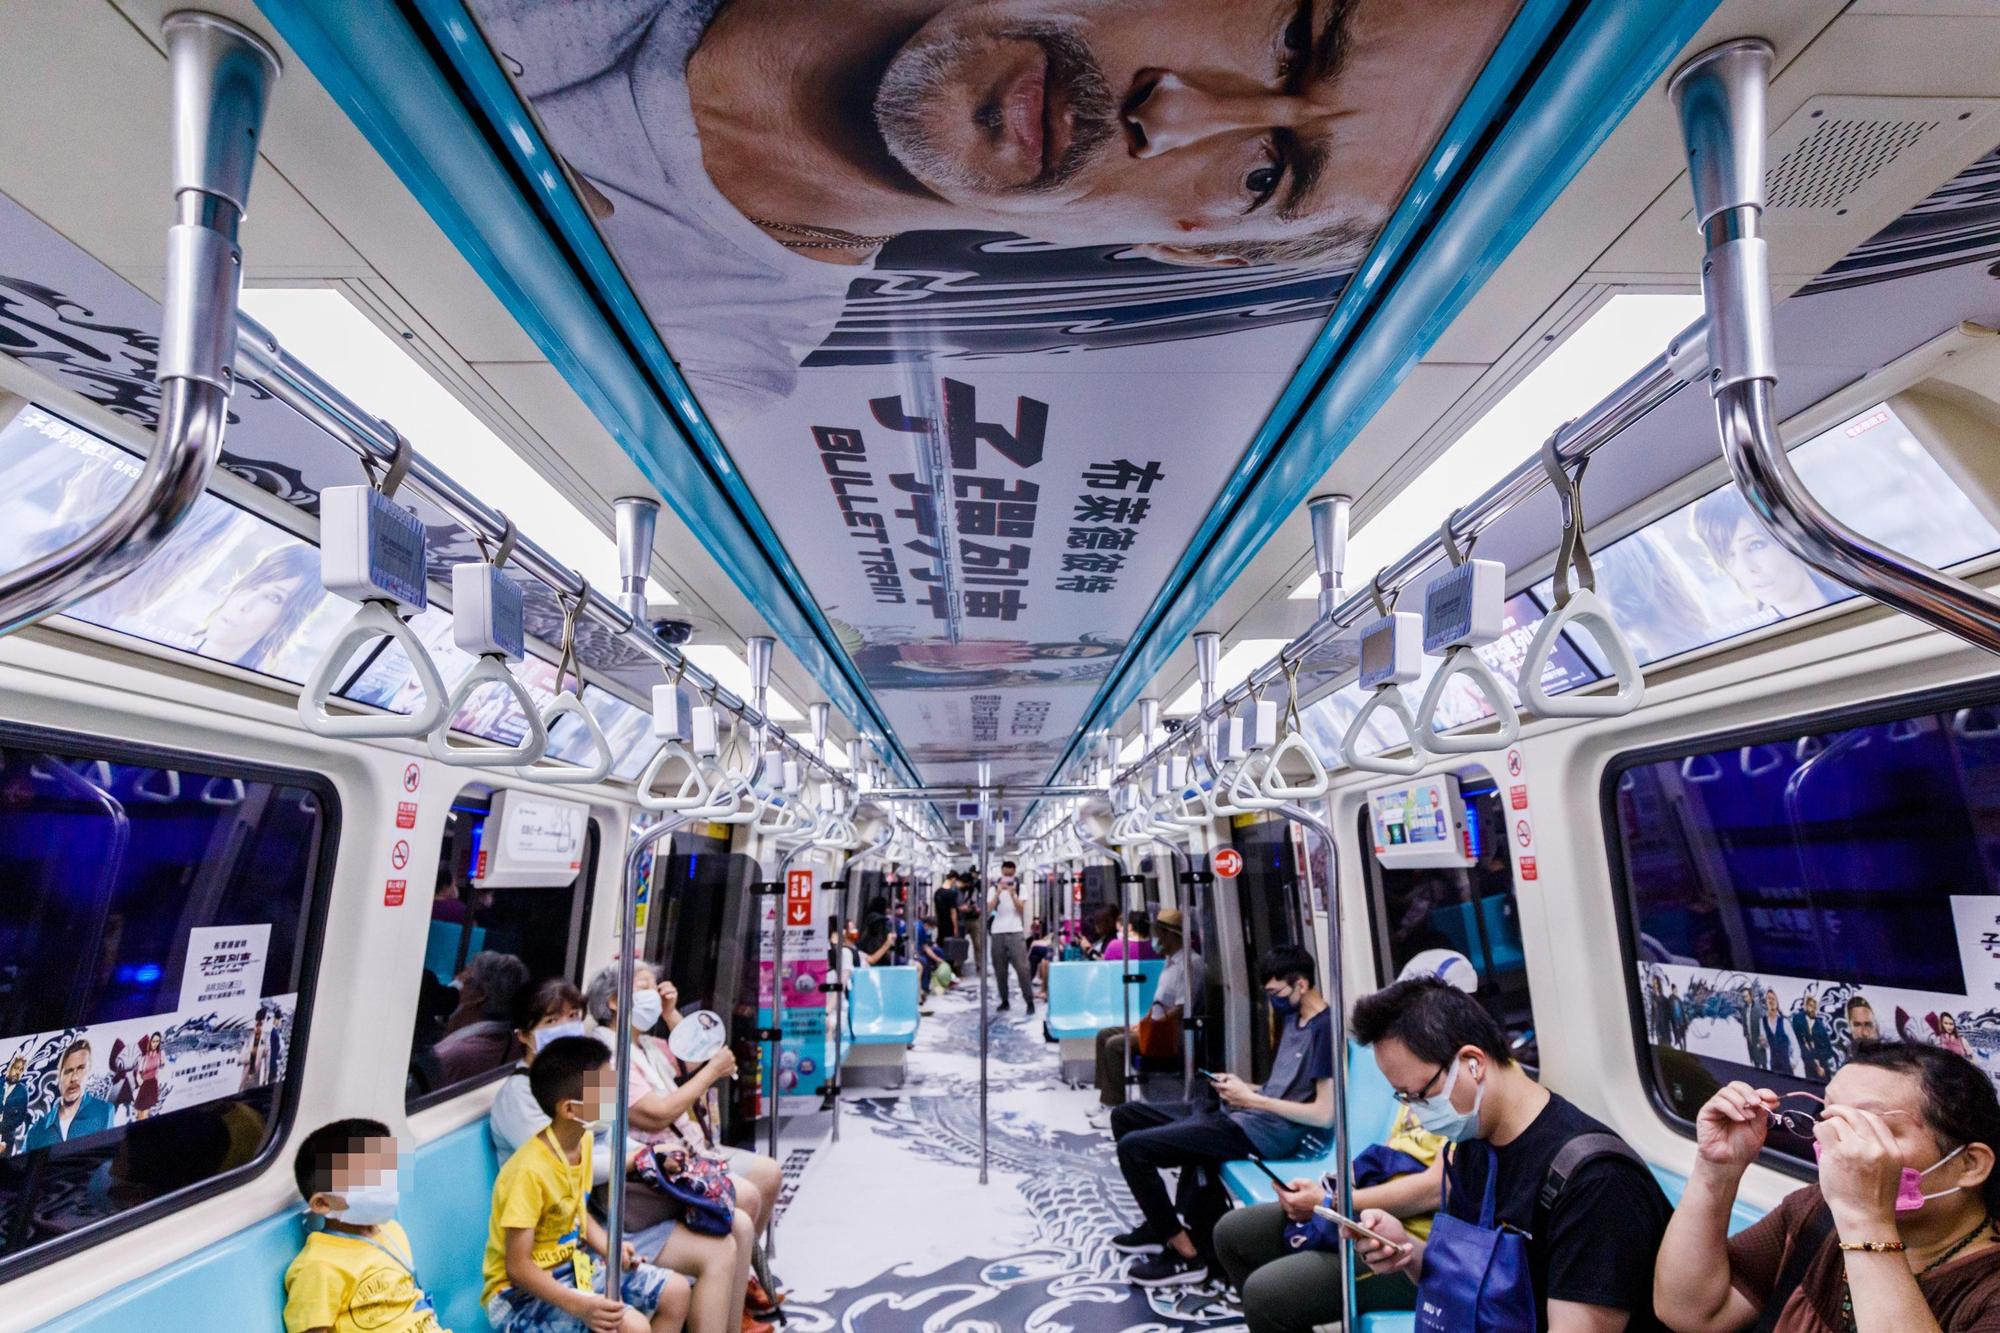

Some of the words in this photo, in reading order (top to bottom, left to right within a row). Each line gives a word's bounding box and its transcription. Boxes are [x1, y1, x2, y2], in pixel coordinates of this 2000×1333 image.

[810, 425, 890, 544] BULLET
[857, 547, 907, 604] TRAIN
[868, 376, 1050, 622] 子彈列車
[1055, 458, 1165, 594] 布萊德彼特
